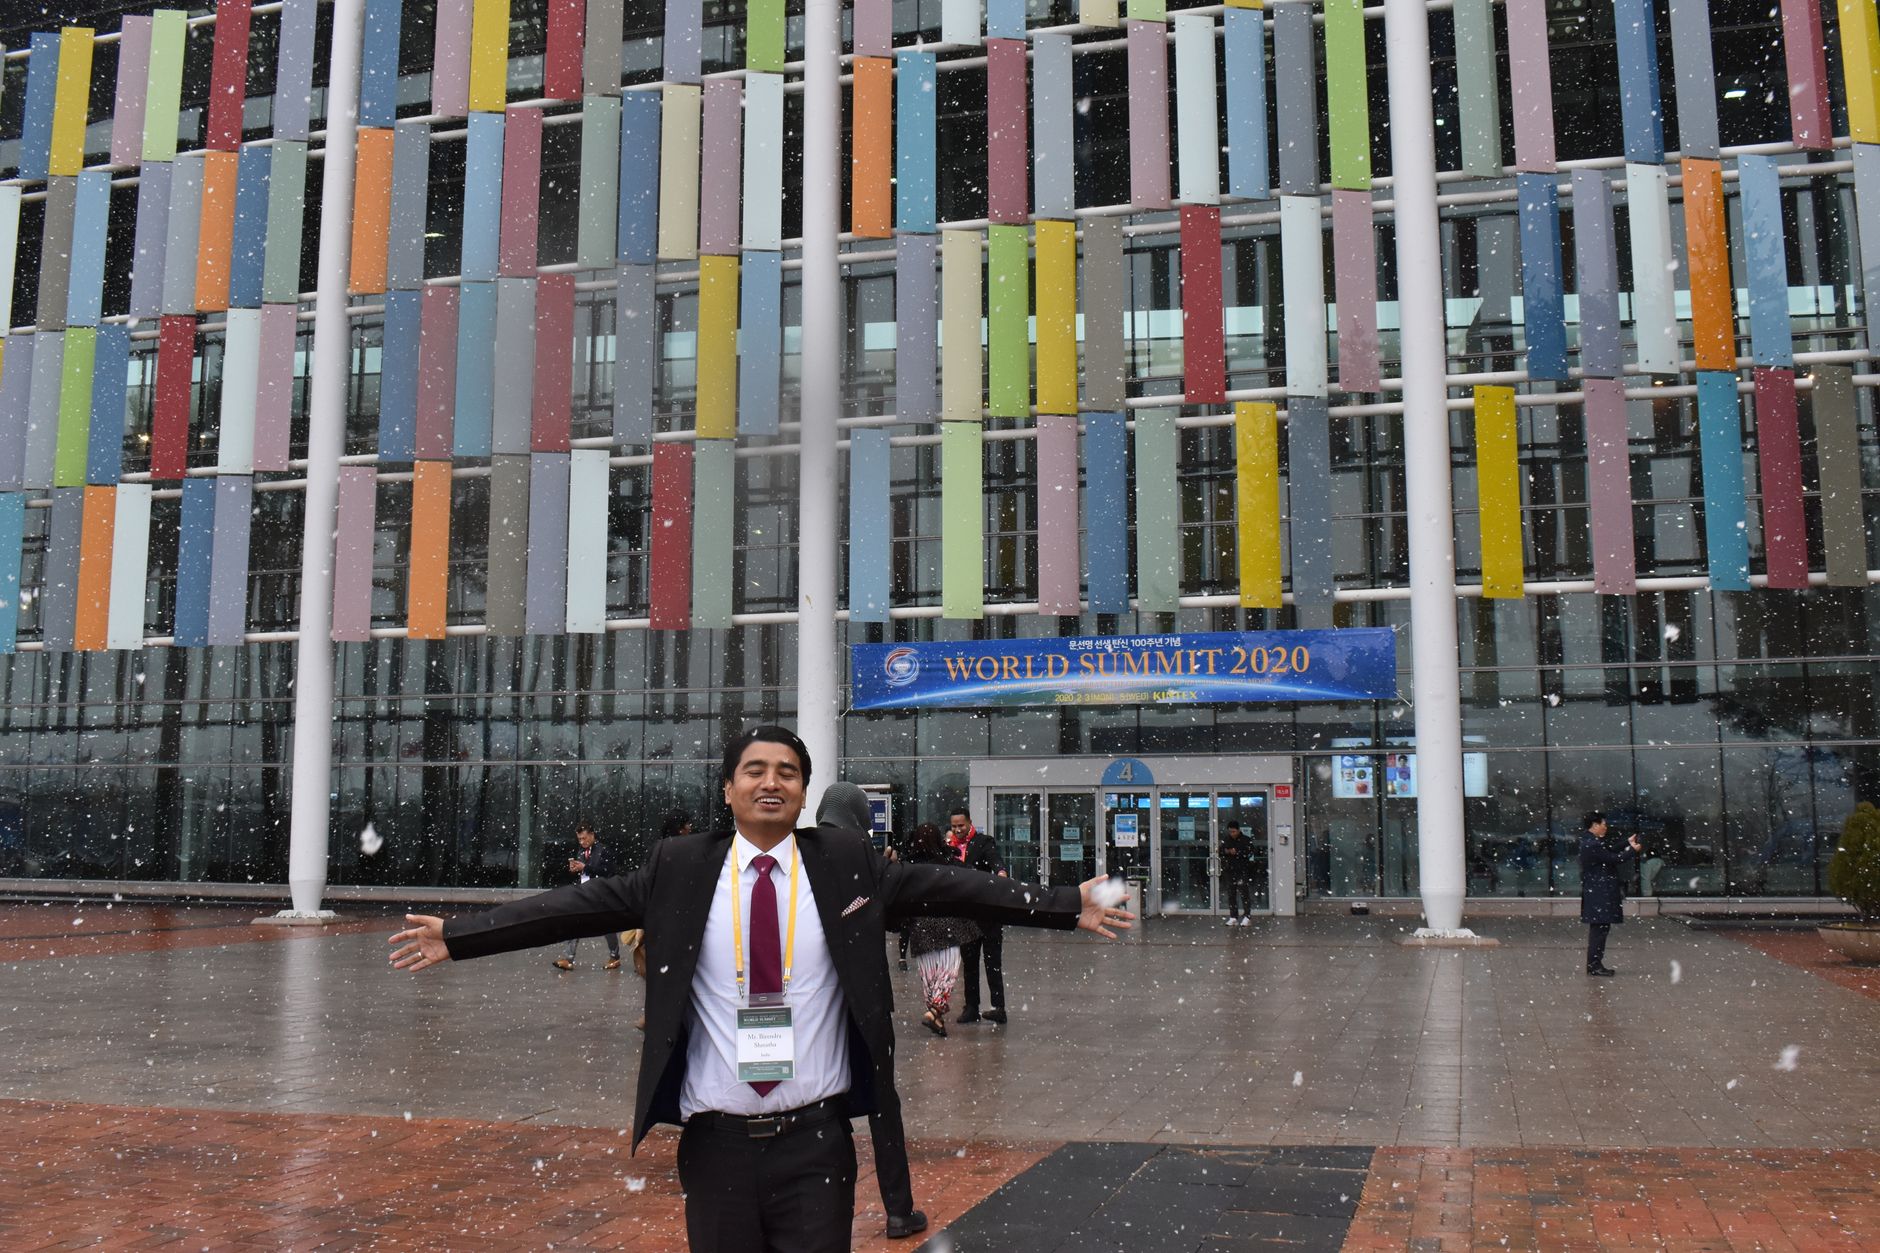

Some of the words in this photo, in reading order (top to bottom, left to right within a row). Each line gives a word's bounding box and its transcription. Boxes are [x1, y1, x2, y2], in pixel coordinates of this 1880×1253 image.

[1069, 639, 1093, 650] 문선명
[1095, 639, 1111, 649] 선생
[1131, 637, 1163, 648] 100주년
[1164, 637, 1181, 646] 기념
[943, 653, 1070, 681] WORLD
[1080, 648, 1223, 678] SUMMIT
[1230, 645, 1310, 675] 2020
[1153, 690, 1198, 701] KINTEX
[1119, 762, 1134, 783] 4
